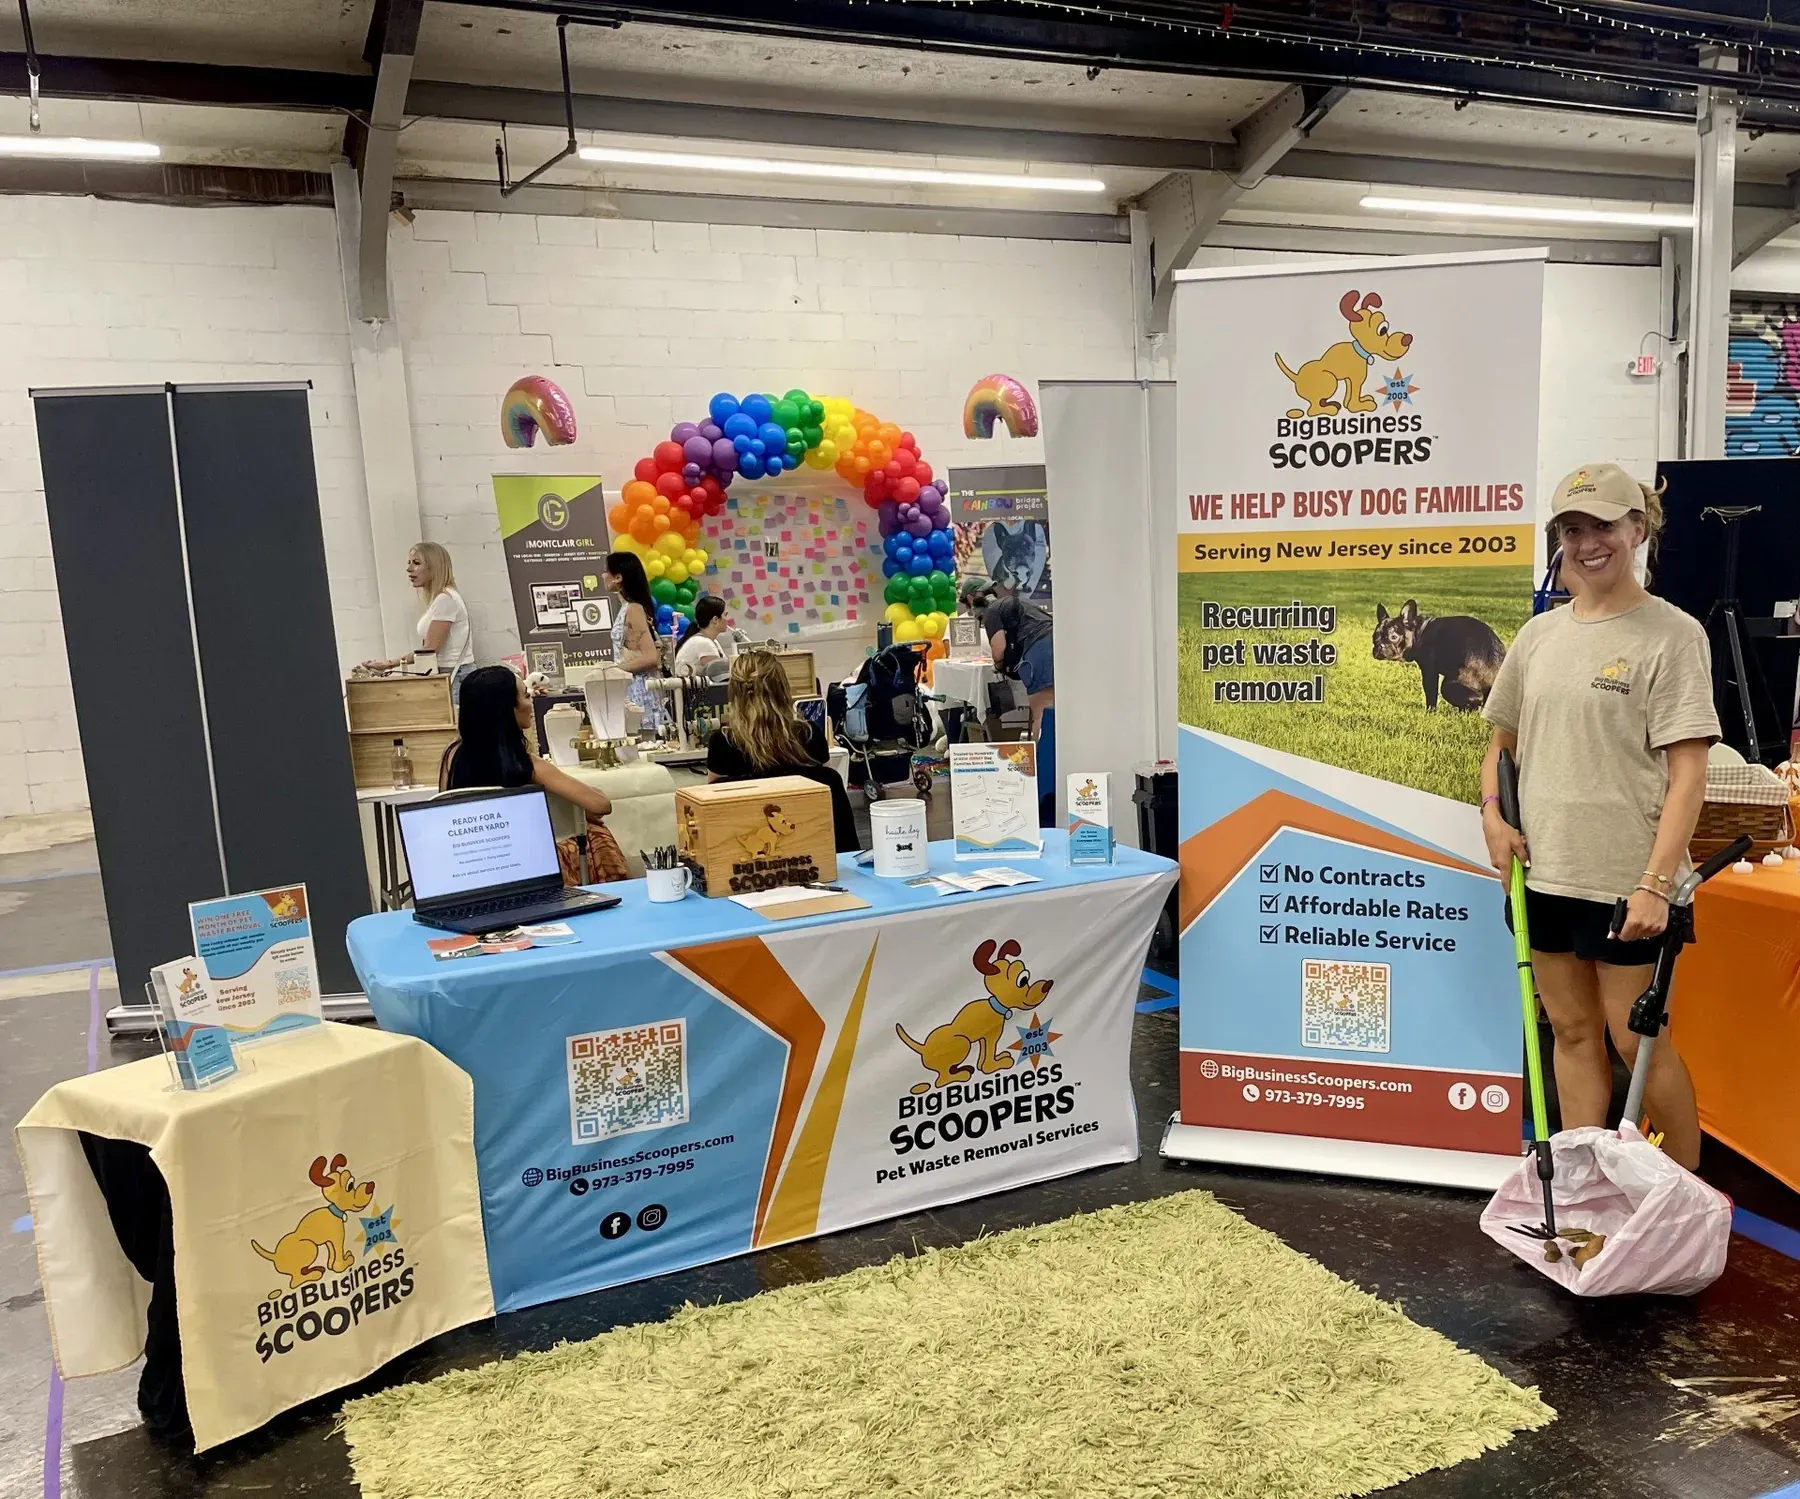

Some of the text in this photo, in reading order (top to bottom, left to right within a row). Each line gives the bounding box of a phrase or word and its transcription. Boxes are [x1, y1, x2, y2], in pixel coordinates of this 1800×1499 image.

[1638, 356, 1654, 373] EXIT
[1387, 392, 1408, 400] 2003
[1269, 437, 1432, 469] SCOOPERS
[1189, 483, 1523, 521] WE HELP BUSY DOG FAMILIES
[576, 539, 594, 547] GIRL
[1194, 536, 1516, 562] Serving New Jersey since 2003
[1202, 601, 1336, 634] Recurring
[585, 649, 611, 657] OUTLET
[1202, 638, 1336, 671] pet waste
[1214, 675, 1323, 702] removal
[1591, 682, 1629, 695] SCOOPERS
[448, 821, 509, 836] CLEANER YARD?
[452, 816, 477, 826] READY
[480, 813, 495, 821] FOR
[729, 866, 819, 892] SCOOPERS
[1284, 865, 1425, 888] No Contracts
[1284, 895, 1468, 921] Affordable Rates
[227, 923, 261, 932] REMOVAL
[1285, 926, 1456, 952] Reliable Service
[220, 985, 248, 995] Serving
[232, 992, 255, 1000] Jersey
[238, 999, 255, 1007] 2003
[1025, 1028, 1044, 1040] est
[1022, 1043, 1048, 1057] 2003
[1221, 1065, 1412, 1093] BigBusinessScoopers.com
[1265, 1089, 1365, 1109] 973-379-7995
[890, 1085, 1075, 1155] SCOOPERS
[546, 1134, 734, 1181] BigBusinessScoopers.com
[876, 1120, 1099, 1183] Pet Waste Removal Services
[592, 1159, 695, 1190] 973-379-7995
[367, 1215, 386, 1230] est
[366, 1229, 392, 1247] 2003
[256, 1267, 414, 1364] SCOOPERS
